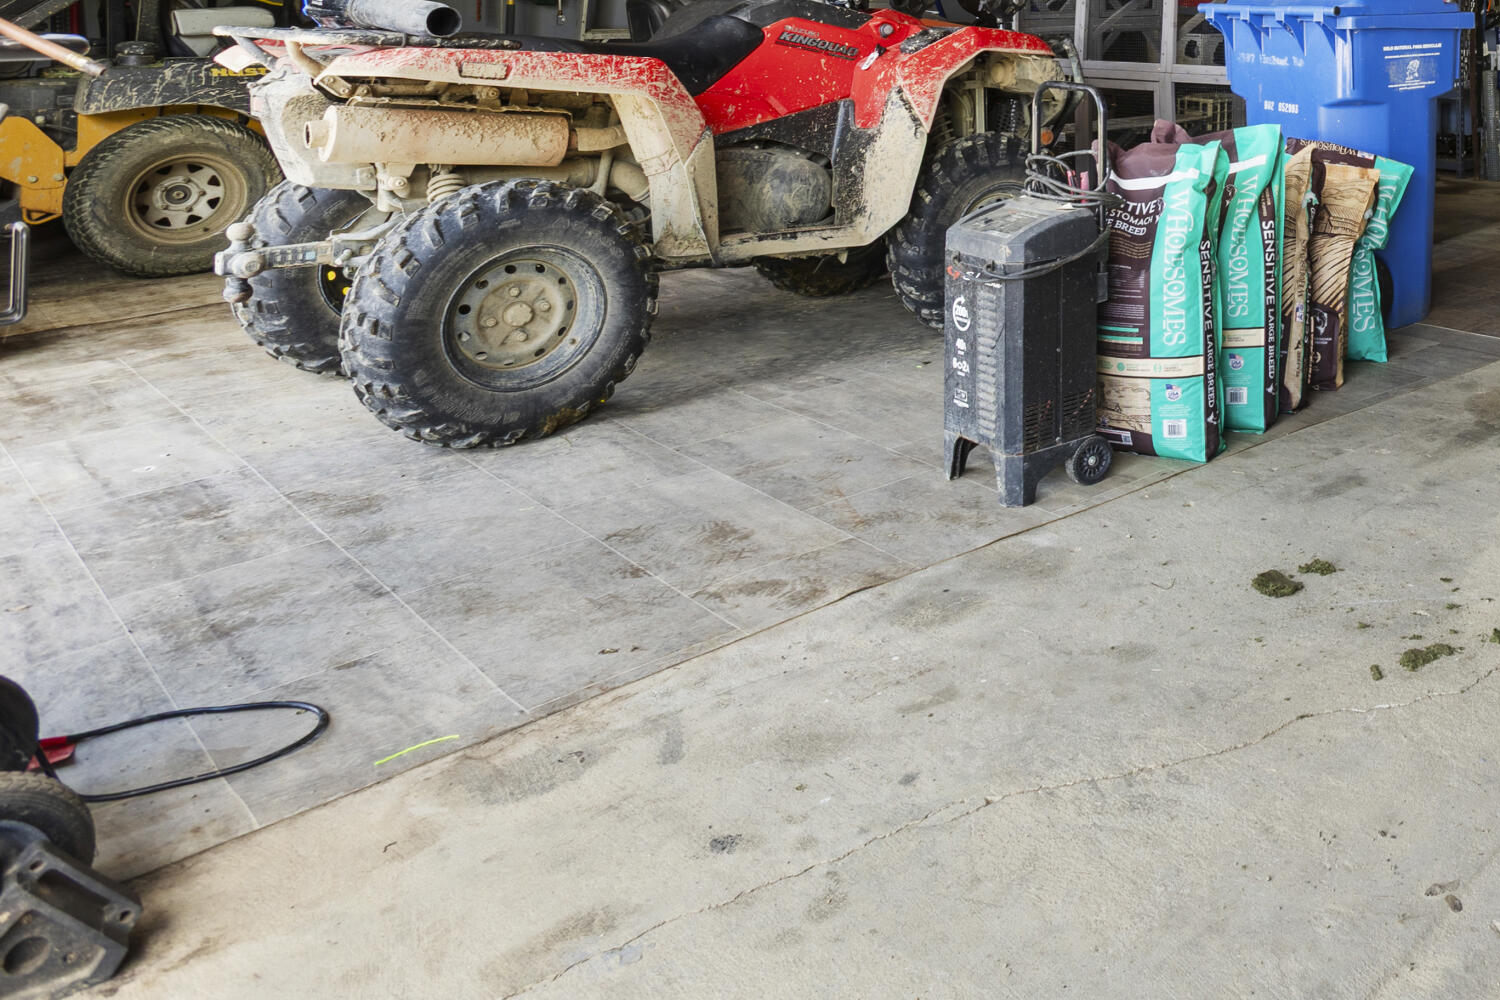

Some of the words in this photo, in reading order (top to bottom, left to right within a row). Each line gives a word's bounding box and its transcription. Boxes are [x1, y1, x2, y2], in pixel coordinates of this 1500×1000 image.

[779, 31, 859, 57] KINGQUAD
[210, 67, 268, 77] HUST
[1110, 208, 1153, 227] STOMACH
[1114, 219, 1147, 236] BREED
[1261, 219, 1275, 306] SENSITIVE
[1200, 240, 1213, 331] SENSITIVE
[1267, 308, 1275, 342] LARGE
[1206, 333, 1215, 371] LARGE
[1206, 373, 1216, 408] BREED
